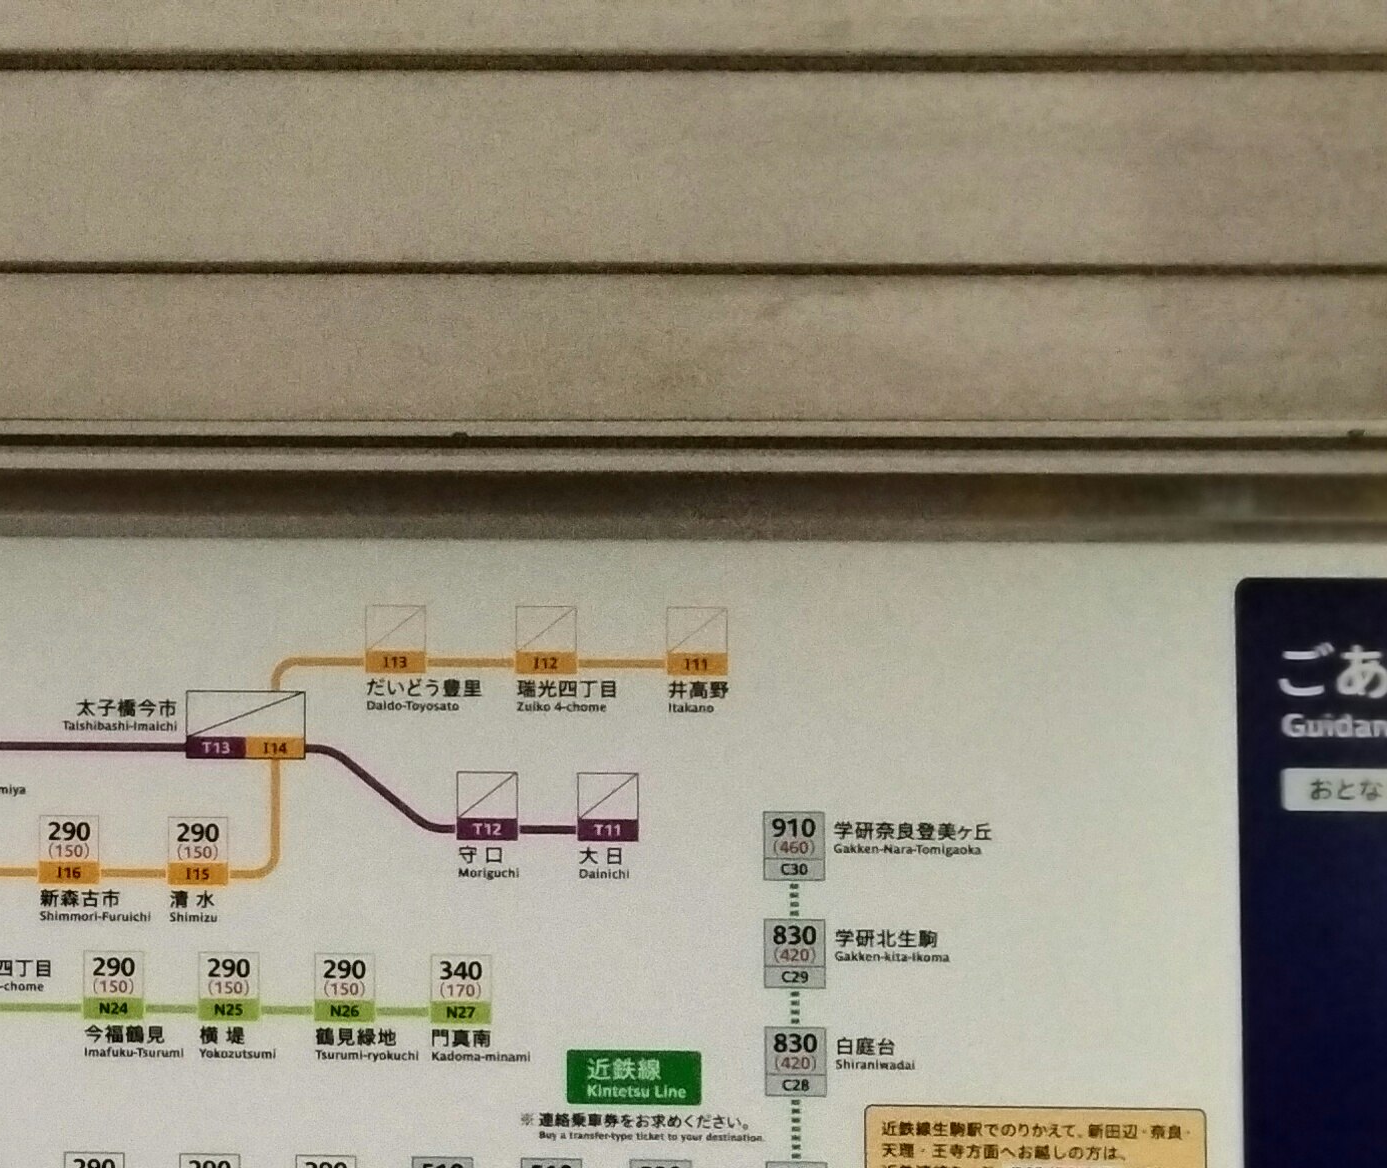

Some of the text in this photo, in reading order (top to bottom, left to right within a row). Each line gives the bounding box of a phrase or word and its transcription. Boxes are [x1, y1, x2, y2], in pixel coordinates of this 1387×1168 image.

[367, 679, 482, 697] だいどう豊里
[517, 680, 616, 698] 瑞光四丁目
[669, 681, 728, 698] 井高野
[78, 699, 176, 717] 太子橋今市
[1311, 780, 1381, 800] おとな
[473, 823, 501, 835] T12
[594, 824, 620, 836] T11
[772, 818, 816, 837] 910
[773, 840, 815, 857] (460)
[459, 868, 519, 880] Moriguchi
[579, 869, 629, 879] Dainichi
[781, 864, 808, 875] C30
[836, 930, 937, 947] 学研北生駒
[837, 1037, 894, 1055] 白庭台
[586, 1062, 661, 1077] 近鉄線
[587, 1085, 686, 1098] Kintetsu Line
